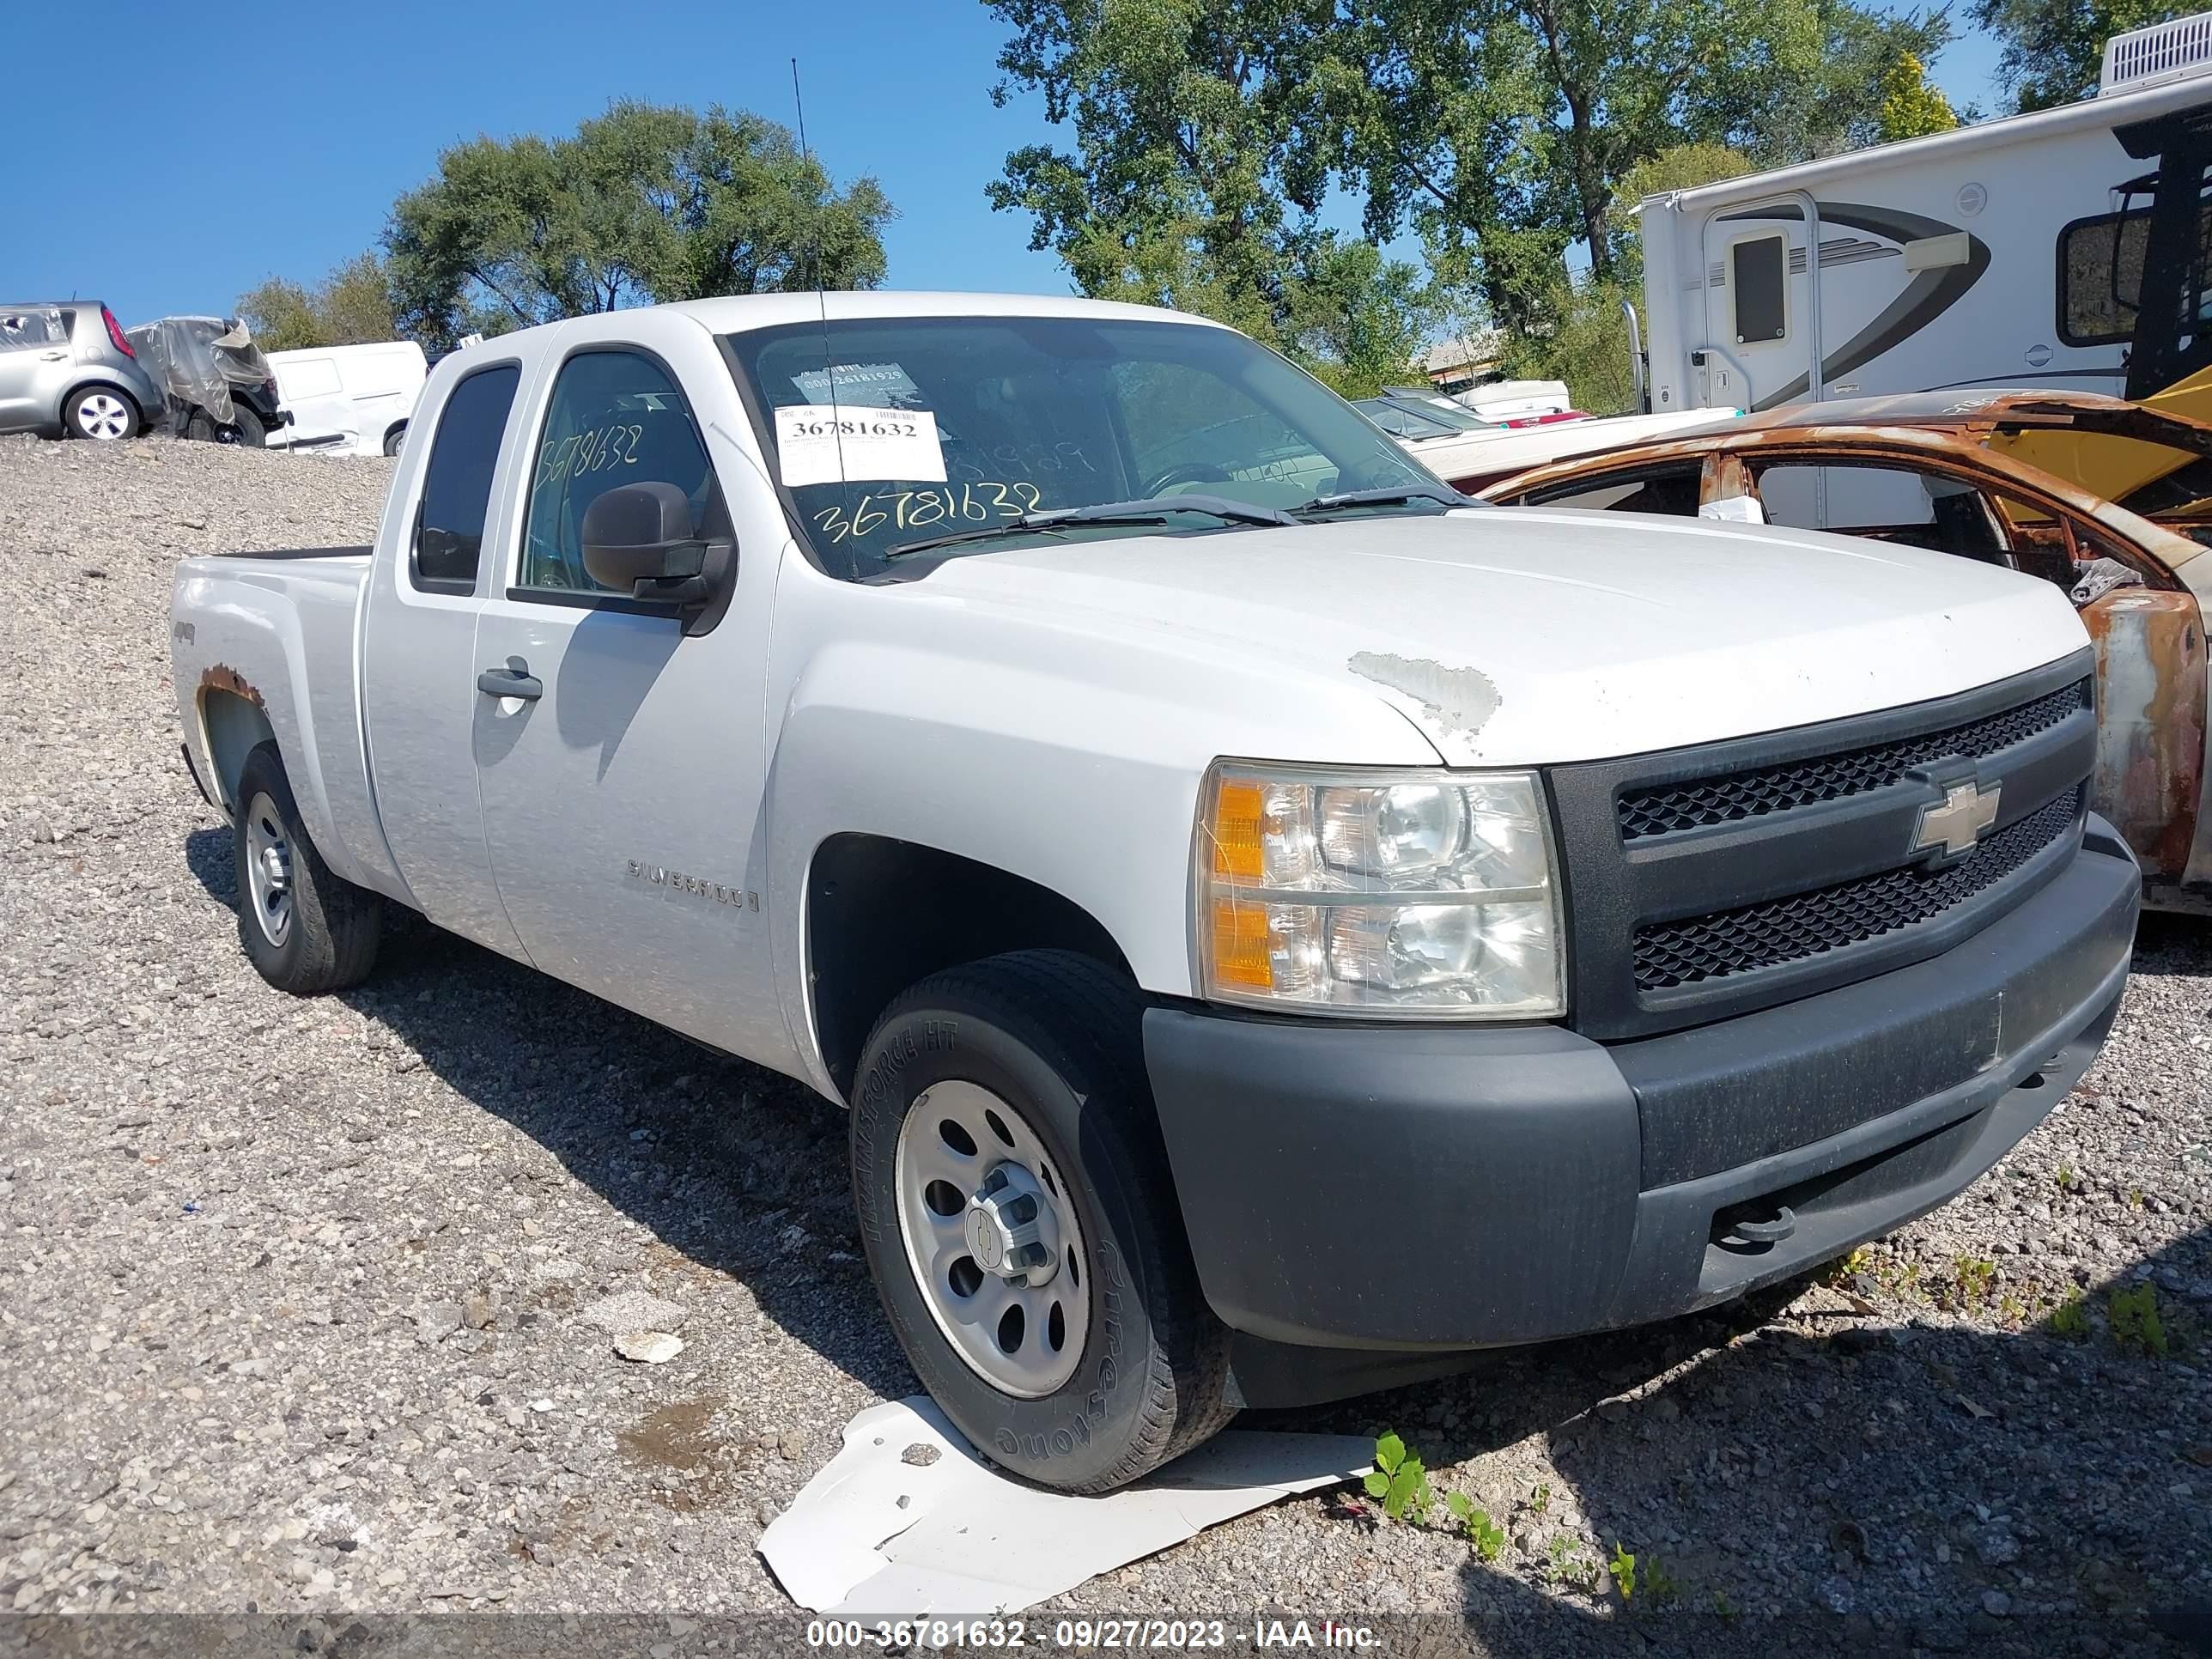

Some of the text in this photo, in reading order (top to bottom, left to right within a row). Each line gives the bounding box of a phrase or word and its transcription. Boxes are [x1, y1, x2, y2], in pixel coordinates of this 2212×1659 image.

[792, 421, 918, 438] 36781632
[812, 483, 1053, 544] 36781632
[626, 859, 760, 913] SILVERADO
[856, 1027, 920, 1243] TRANSFORCE
[923, 1019, 958, 1053] HT
[995, 1239, 1127, 1462] Firestone
